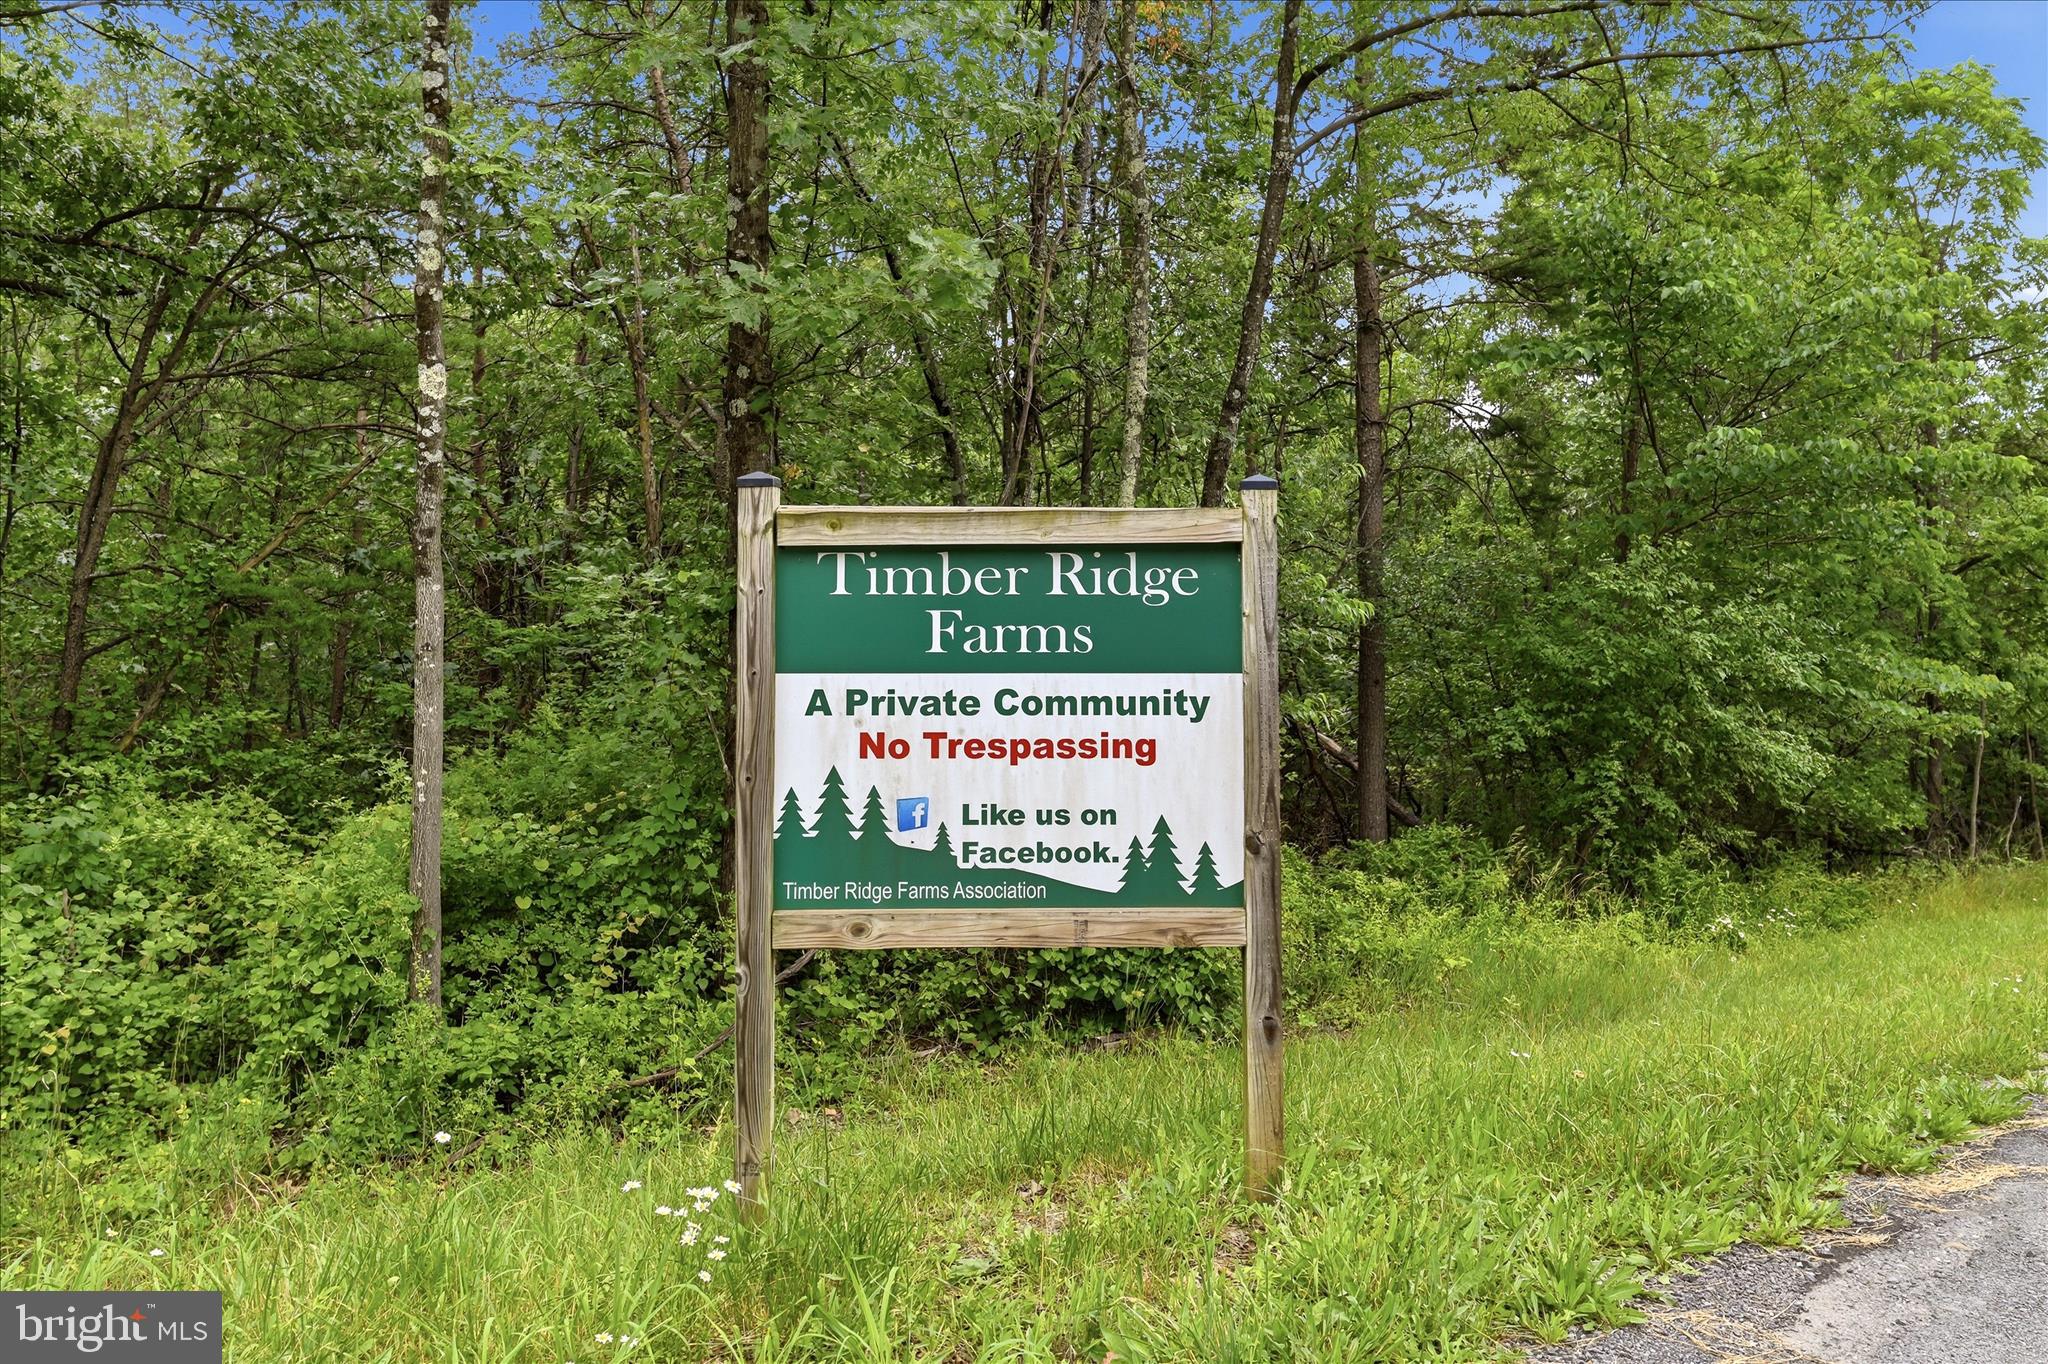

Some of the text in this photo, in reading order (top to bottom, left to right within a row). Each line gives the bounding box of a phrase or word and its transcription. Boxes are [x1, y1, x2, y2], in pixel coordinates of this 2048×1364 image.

[817, 551, 1200, 606] Timber Ridge
[925, 609, 1094, 654] Farms
[804, 688, 1211, 723] A Private Community
[858, 731, 1157, 766] No Trespassing
[961, 803, 1118, 826] Like us on
[961, 841, 1120, 864] Facebook.
[782, 881, 1047, 905] Timber Ridge Farms Association
